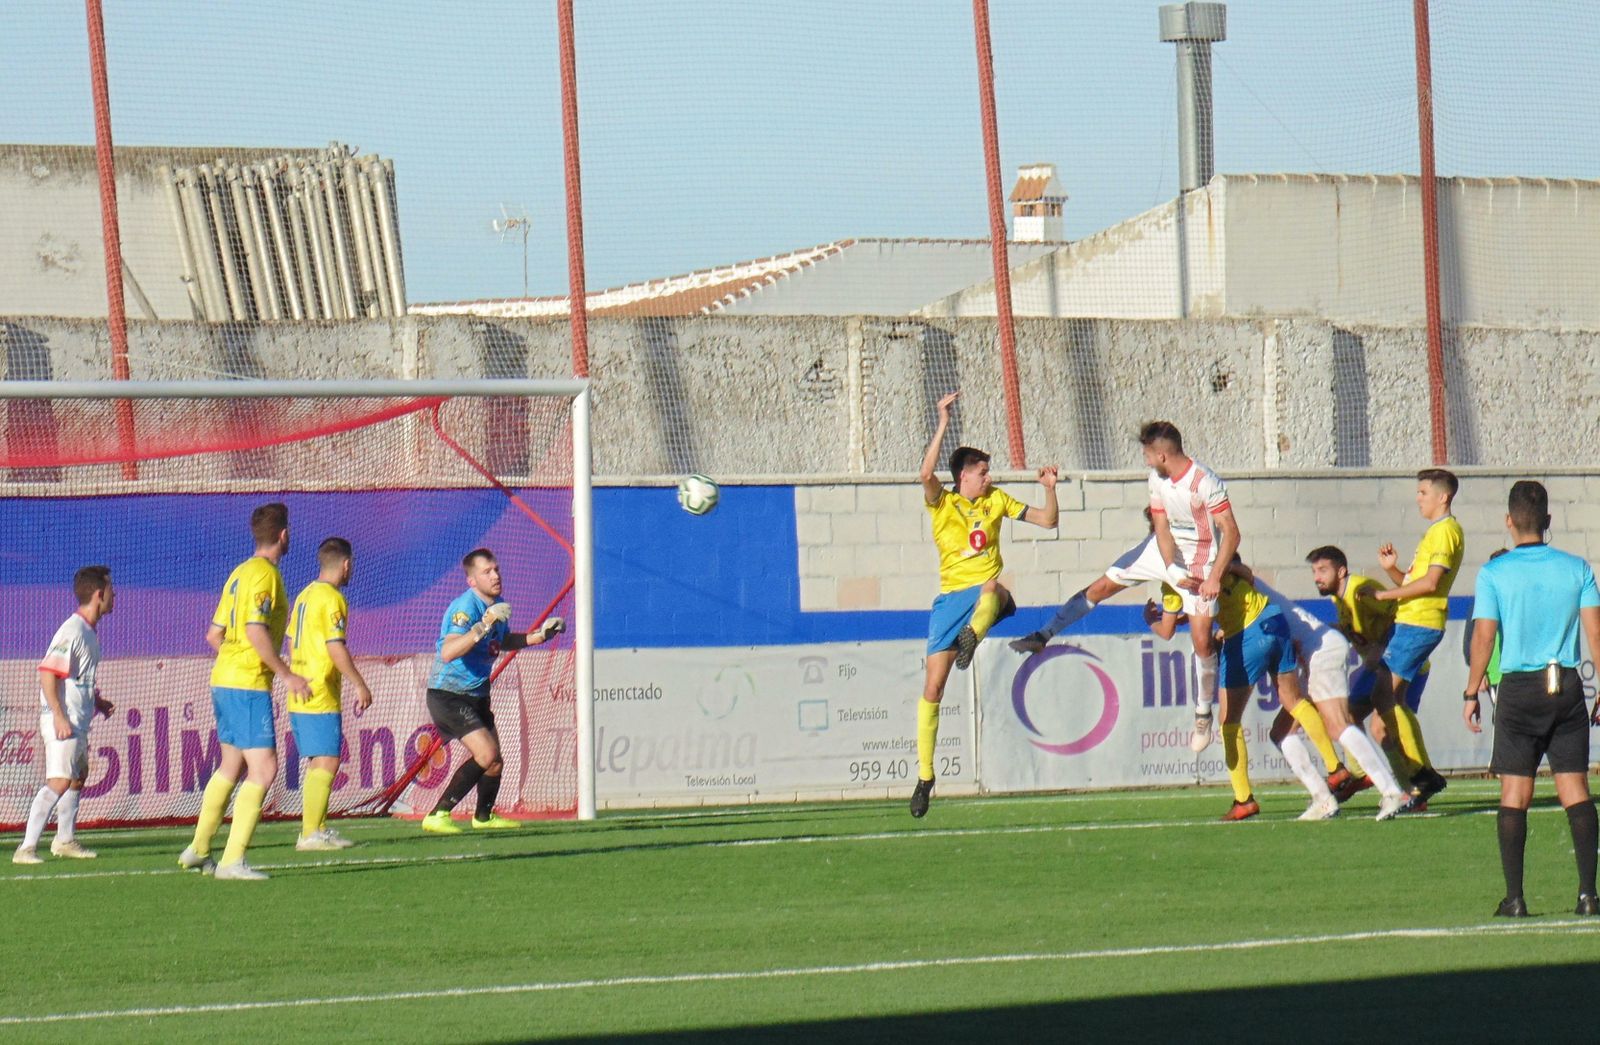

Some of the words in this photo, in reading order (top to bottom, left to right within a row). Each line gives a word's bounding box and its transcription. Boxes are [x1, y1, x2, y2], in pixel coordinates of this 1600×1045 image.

[838, 664, 857, 680] Fijo
[838, 707, 888, 722] Televisión
[850, 761, 881, 782] 959
[887, 759, 908, 778] 40
[940, 756, 961, 776] 25
[685, 774, 731, 788] Televisión
[733, 774, 756, 787] Local
